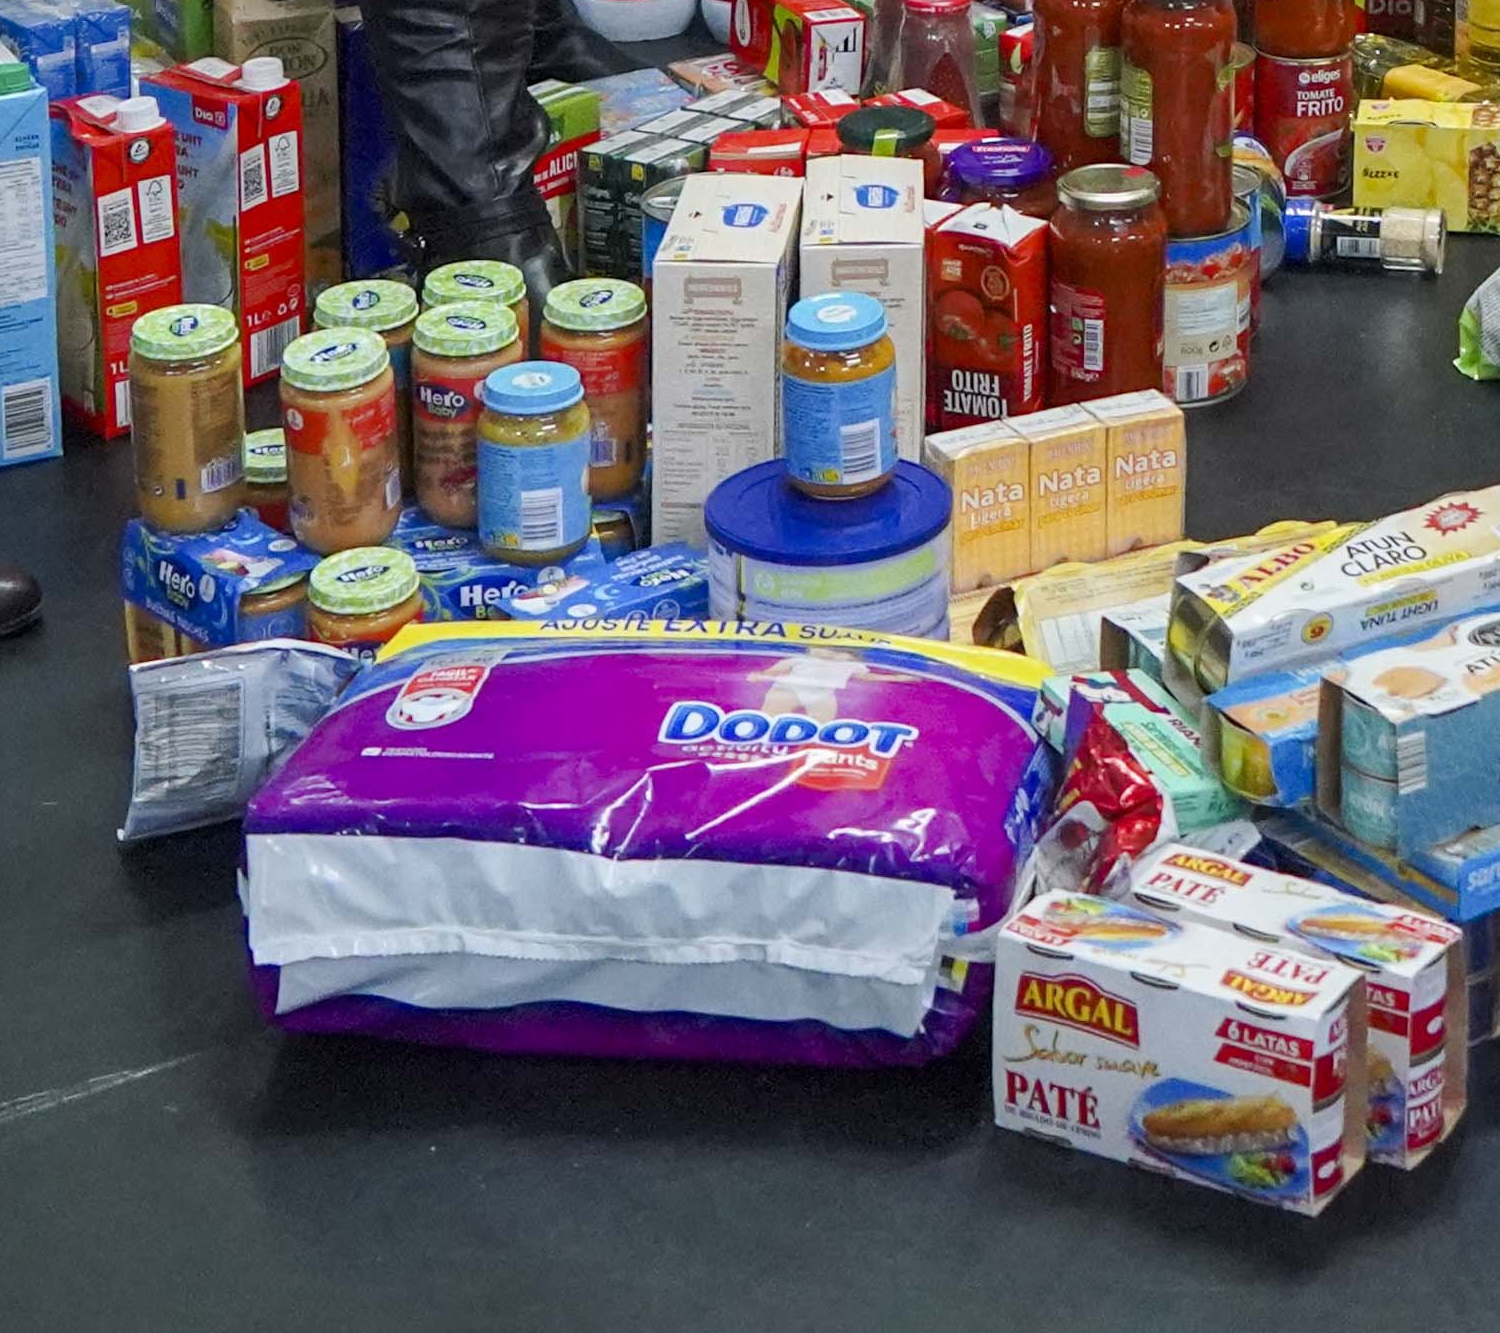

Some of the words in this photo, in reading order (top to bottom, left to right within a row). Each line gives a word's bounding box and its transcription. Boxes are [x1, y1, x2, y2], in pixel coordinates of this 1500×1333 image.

[1311, 69, 1341, 84] eliges
[1296, 89, 1335, 100] TOMATE
[1296, 96, 1344, 117] FRITO
[419, 385, 466, 409] Hero
[951, 370, 1000, 397] FRITO
[427, 402, 458, 419] Baby
[1114, 447, 1178, 480] Nata
[960, 479, 1025, 513] Nata
[1038, 464, 1101, 497] Nata
[342, 564, 387, 584] Hero
[1239, 540, 1316, 590] ALBO
[1340, 545, 1428, 578] CLARO
[158, 560, 196, 599] Hero
[167, 589, 194, 611] Baby
[665, 619, 784, 639] EXTRA
[661, 704, 918, 756] DODOT
[1169, 853, 1250, 886] ARGAL
[1145, 870, 1228, 904] PATÉ
[1249, 950, 1328, 985] PATÉ
[1021, 984, 1133, 1036] ARGAL
[1003, 1025, 1087, 1063] Sabor
[1096, 1054, 1160, 1079] suave
[1242, 1029, 1301, 1057] LATAS
[1004, 1068, 1101, 1129] PATÉ
